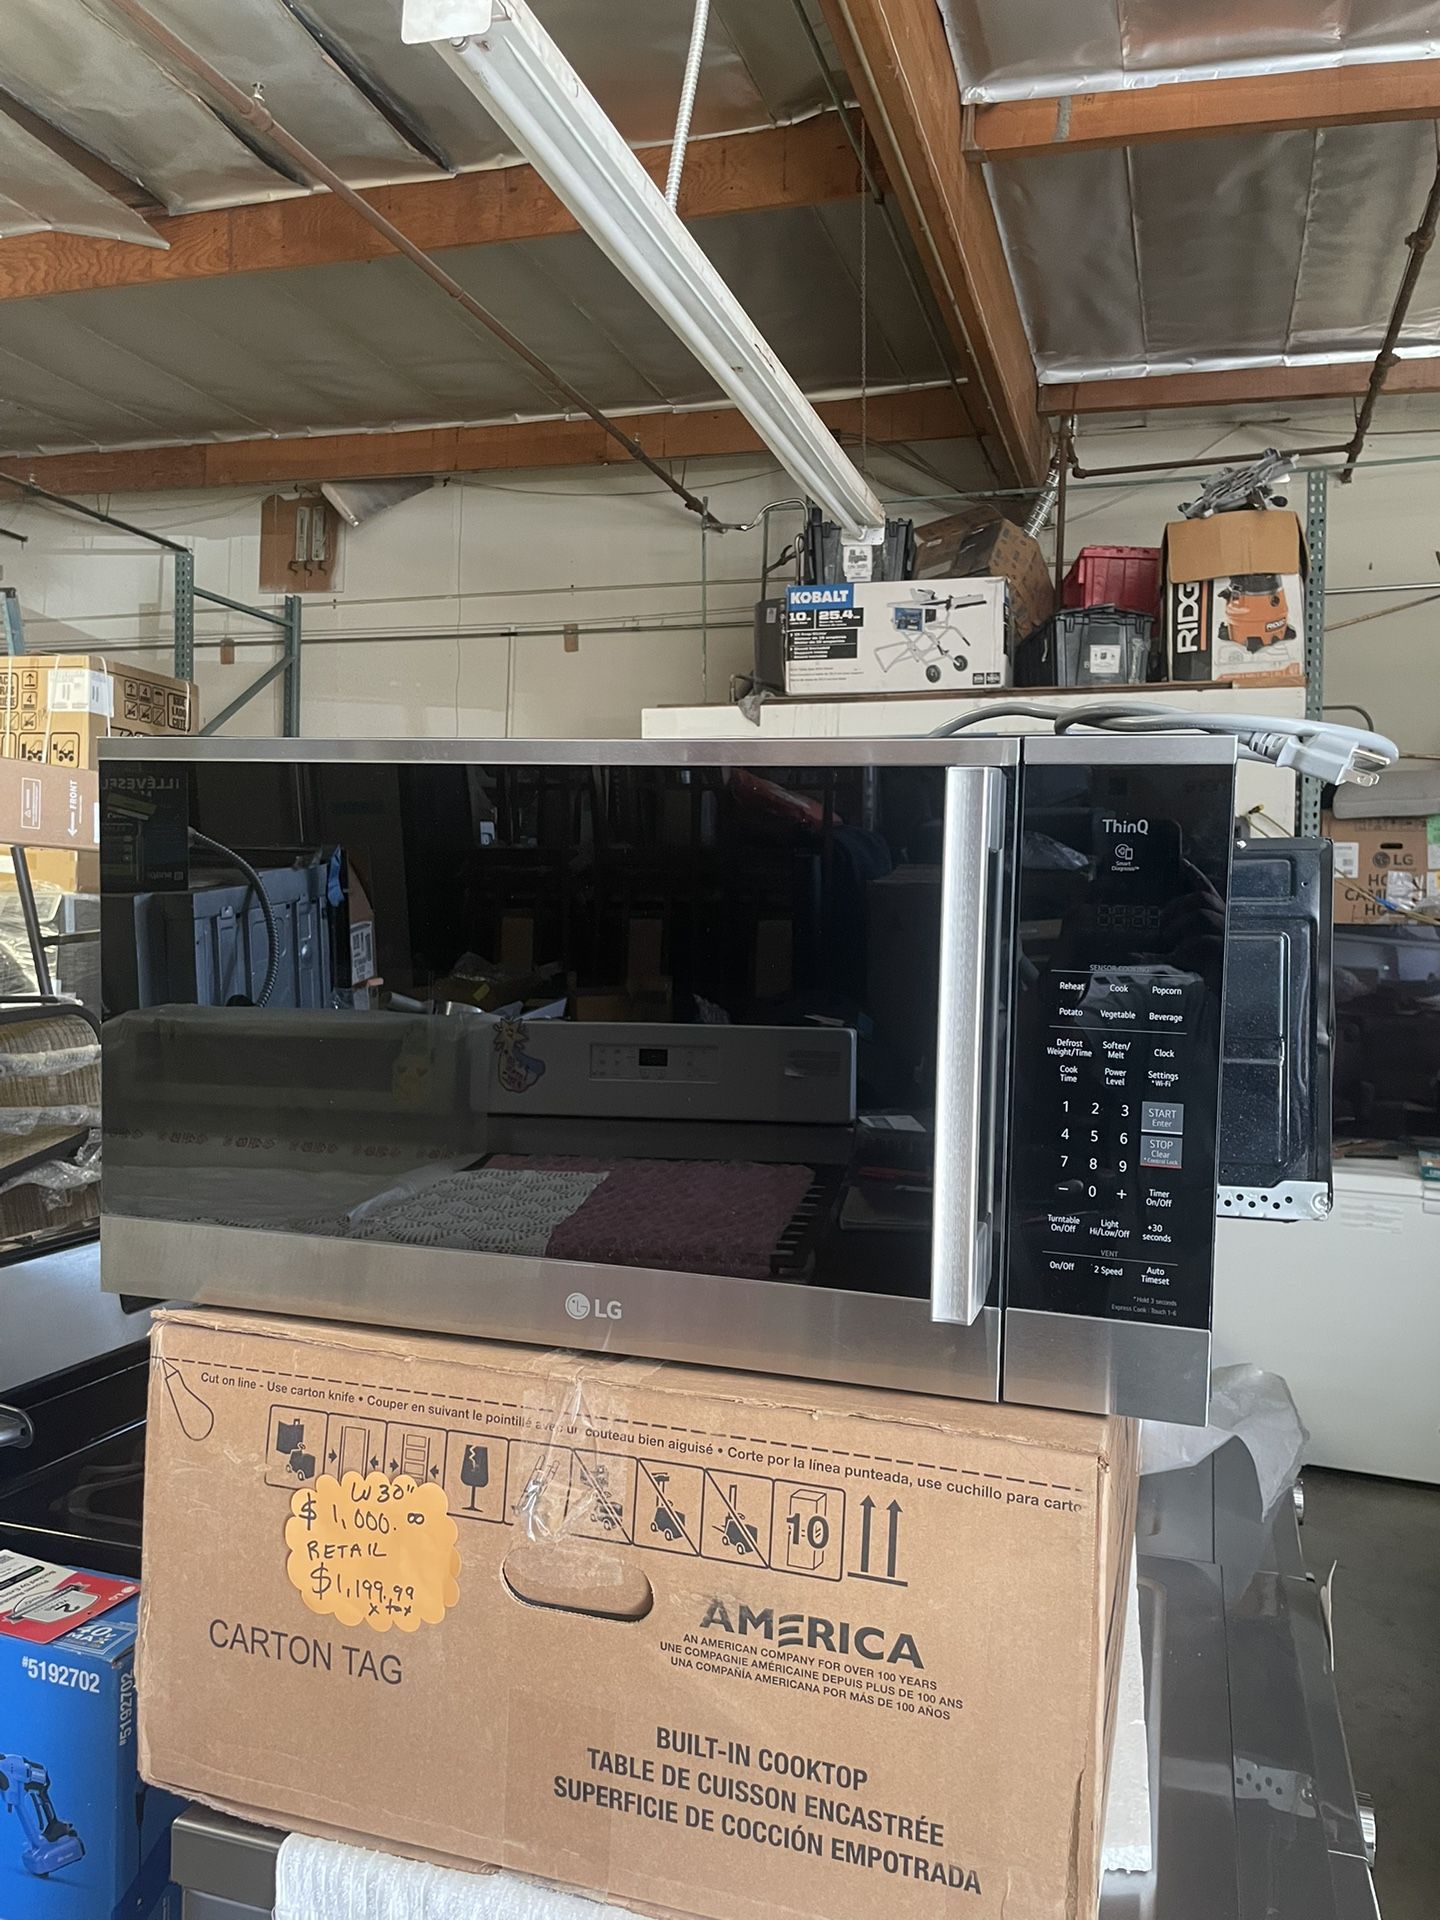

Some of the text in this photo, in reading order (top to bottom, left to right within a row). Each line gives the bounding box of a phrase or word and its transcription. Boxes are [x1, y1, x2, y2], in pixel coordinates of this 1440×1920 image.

[790, 590, 849, 604] KOBALT
[69, 779, 78, 810] FRONT
[1102, 819, 1149, 835] ThinQ
[1059, 982, 1085, 991] Reheat
[1110, 984, 1129, 993] Cook
[1152, 986, 1183, 996] Popcorn
[1059, 1007, 1084, 1017] Potato
[1100, 1010, 1136, 1020] Vegetable
[1149, 1013, 1183, 1023] Beverage
[1056, 1038, 1083, 1048] Defrost
[1102, 1041, 1131, 1050] Soften/
[1047, 1047, 1093, 1058] Weight/Time
[1107, 1050, 1125, 1060] Melt
[1154, 1049, 1175, 1058] Clock
[1059, 1064, 1078, 1074] Cook
[1104, 1067, 1127, 1077] Power
[1060, 1074, 1078, 1083] Time
[1105, 1077, 1125, 1086] Level
[1148, 1070, 1179, 1082] Settings
[1063, 1101, 1070, 1113] 1
[1091, 1102, 1100, 1115] 2
[1121, 1104, 1129, 1117] 3
[1148, 1108, 1177, 1119] START
[1152, 1119, 1172, 1128] Enter
[1061, 1128, 1070, 1140] 4
[1090, 1130, 1099, 1142] 5
[1119, 1132, 1128, 1145] 6
[1149, 1139, 1174, 1150] STOP
[1151, 1150, 1171, 1159] Clear
[1061, 1155, 1069, 1168] 7
[1089, 1158, 1098, 1170] 8
[1119, 1160, 1128, 1173] 9
[1088, 1185, 1097, 1198] 0
[1149, 1188, 1170, 1199] Timer
[1146, 1198, 1173, 1208] On/Off
[1047, 1214, 1081, 1225] Turntable
[1100, 1219, 1120, 1229] Light
[1050, 1224, 1076, 1233] On/Off
[1089, 1227, 1131, 1239] Hi/Low/Off
[1142, 1233, 1172, 1243] seconds
[1100, 1250, 1119, 1258] VENT
[1049, 1261, 1075, 1271] On/Off
[1093, 1265, 1124, 1276] 2 Speed
[1146, 1266, 1165, 1276] Auto
[1141, 1275, 1170, 1286] Timeset
[594, 1299, 622, 1320] LG
[201, 1372, 220, 1385] Cut
[222, 1377, 235, 1387] on
[237, 1377, 257, 1390] line
[267, 1381, 288, 1394] Use
[290, 1386, 326, 1399] carton
[328, 1389, 355, 1403] knife
[367, 1395, 409, 1411] Couper
[411, 1403, 425, 1413] en
[428, 1404, 469, 1420] suivant
[472, 1409, 483, 1421] le
[585, 1427, 635, 1444] couteau
[638, 1433, 665, 1448] bien
[668, 1439, 714, 1455] aiguisé
[727, 1447, 764, 1463] Corte
[767, 1455, 790, 1467] por
[793, 1456, 805, 1469] la
[809, 1459, 841, 1474] línea
[844, 1467, 913, 1488] punteada,
[917, 1477, 943, 1490] use
[946, 1482, 1002, 1500] cuchillo
[1006, 1490, 1039, 1506] para
[786, 1512, 830, 1550] 10
[307, 1540, 387, 1561] RETAIL
[699, 1599, 925, 1670] AMERICA
[209, 1618, 403, 1685] CARTON TAG
[683, 1633, 938, 1691] AN AMERICAN COMPANY FOR OVER 100 YEARS
[22, 1655, 100, 1694] #5192702
[660, 1641, 964, 1709] UNE COMPAGNIE AMÉRICAINE DEPUIS PLUS DE 100 ANS
[670, 1656, 951, 1720] UNA COMPAÑÍA AMERICANA POR MÁS DE 100 AÑOS
[119, 1669, 134, 1746] #5192702
[656, 1726, 868, 1791] BUILT-IN COOKTOP
[586, 1747, 944, 1848] TABLE DE CUISSON ENCASTRÉE
[553, 1775, 982, 1896] SUPERFICIE DE COCCIÓN EMPOTRADA
